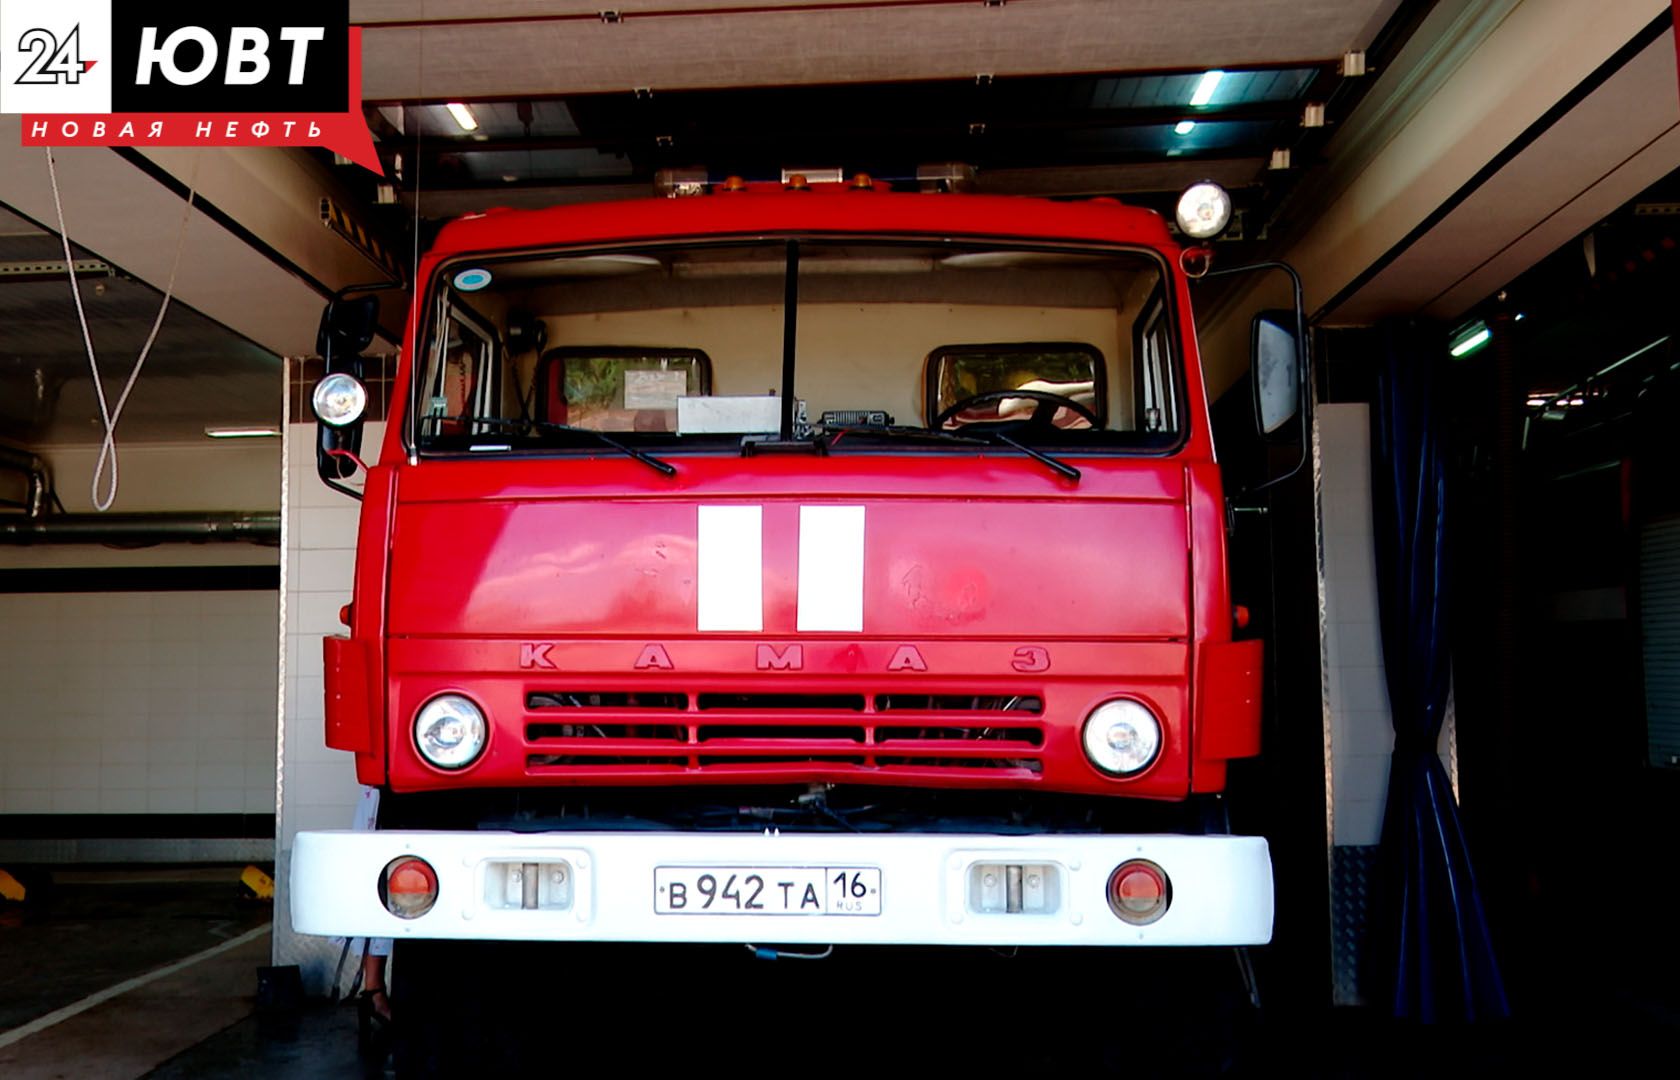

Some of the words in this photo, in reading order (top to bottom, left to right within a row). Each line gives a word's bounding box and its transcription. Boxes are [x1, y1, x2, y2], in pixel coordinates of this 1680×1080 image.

[519, 643, 1051, 671] КАМАЗ
[833, 872, 867, 898] 16
[836, 901, 863, 912] RUS
